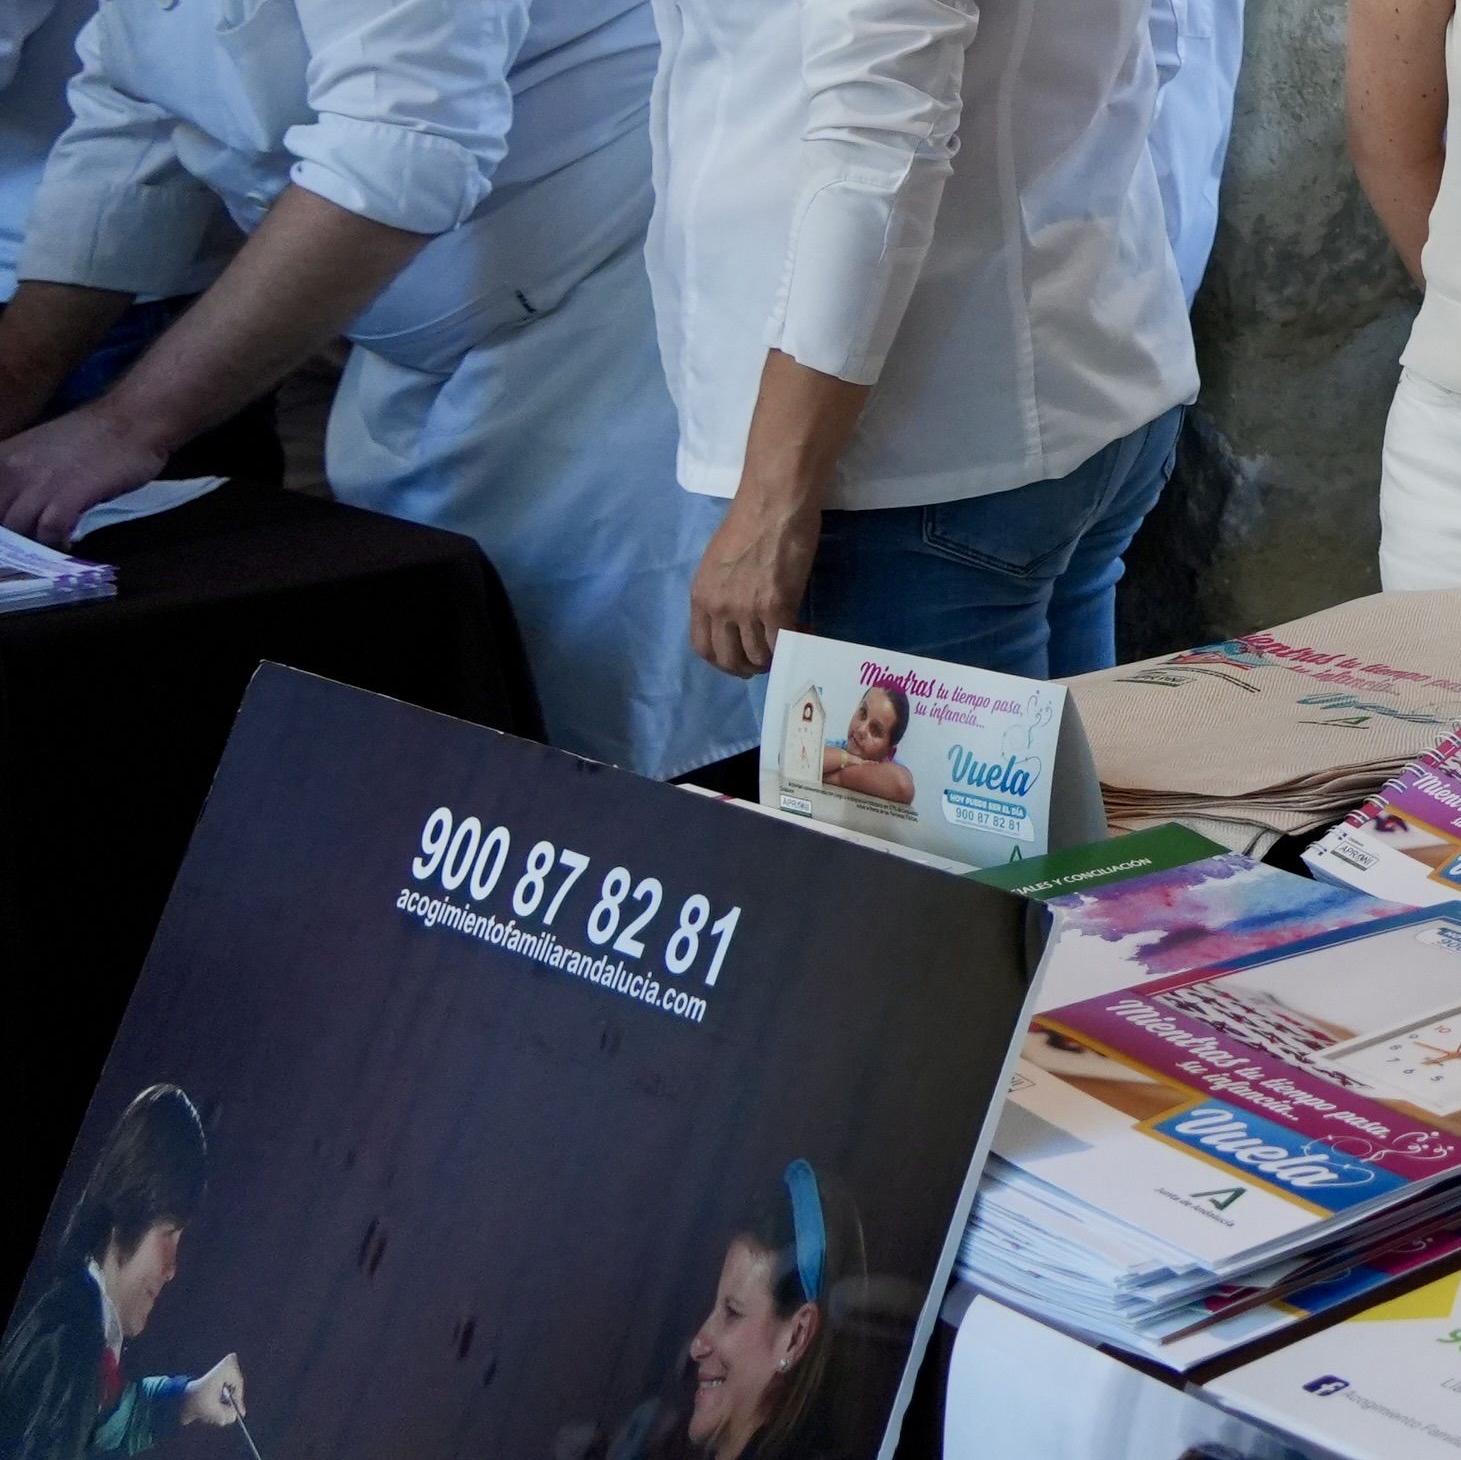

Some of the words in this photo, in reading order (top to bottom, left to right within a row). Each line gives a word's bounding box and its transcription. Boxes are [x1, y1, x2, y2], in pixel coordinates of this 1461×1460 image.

[860, 661, 936, 699] Mientras
[951, 685, 991, 711] tiempo
[914, 701, 928, 717] su
[947, 744, 1032, 798] Vuela
[956, 807, 974, 821] 900
[977, 811, 990, 825] 87
[992, 816, 1006, 829] 82
[1008, 820, 1021, 832] 81
[411, 805, 512, 902] 900
[511, 840, 592, 927] 87
[586, 865, 665, 960] 82
[663, 892, 743, 988] 81
[1062, 856, 1152, 886] CONCILIACIÓN
[396, 887, 708, 1024] acogimientofamiliarandalucia.com
[1106, 999, 1250, 1069] Mientras
[1235, 1066, 1265, 1082] tu
[1260, 1077, 1337, 1120] tiempo
[1175, 1060, 1209, 1076] su
[1174, 1107, 1339, 1188] Vuela
